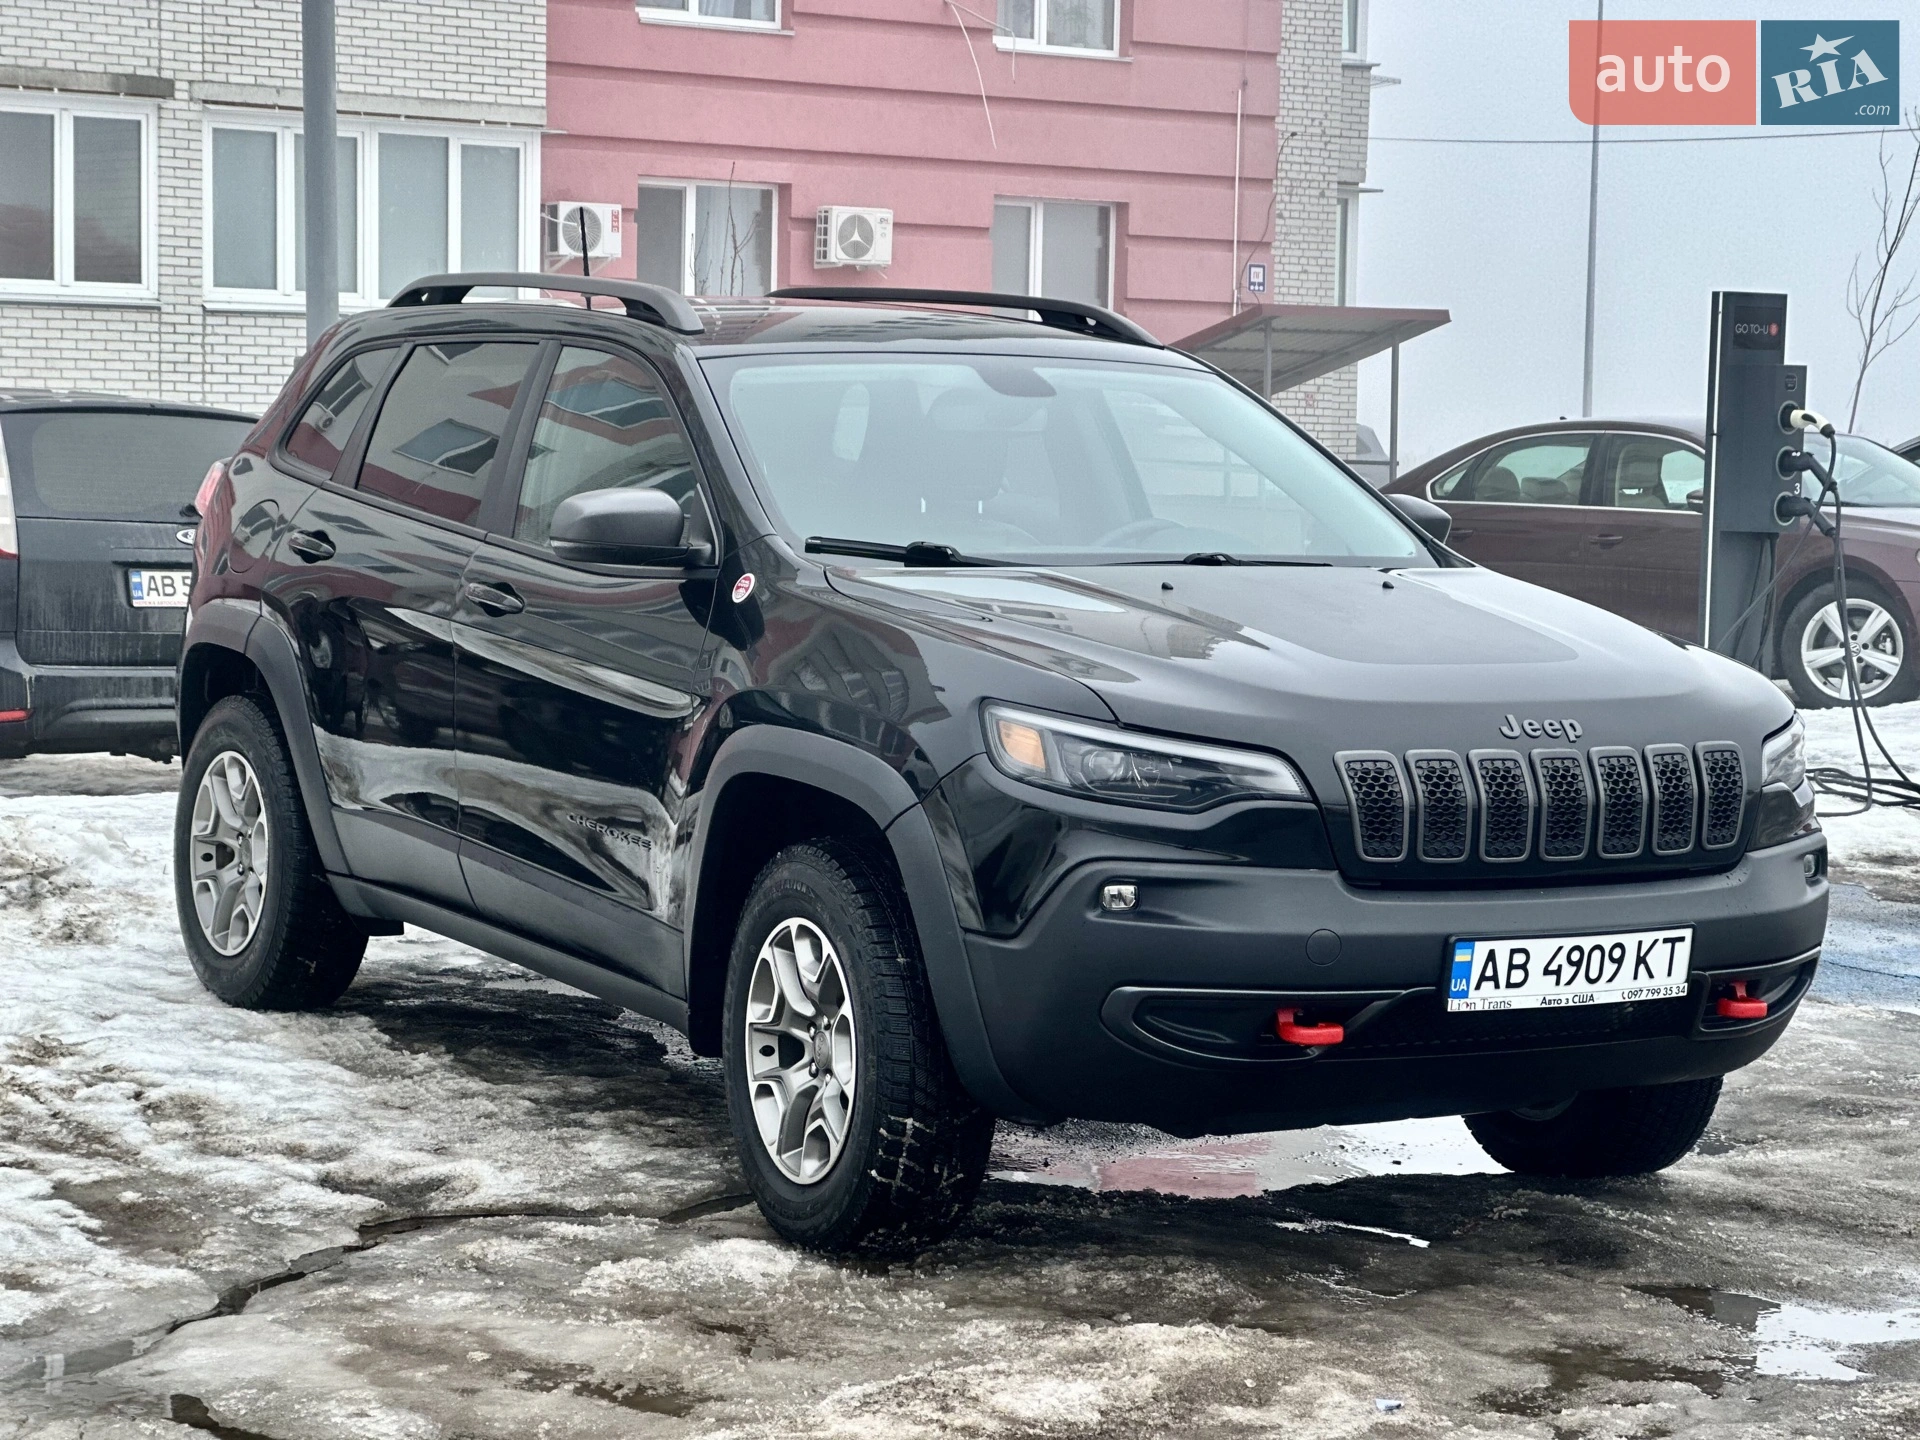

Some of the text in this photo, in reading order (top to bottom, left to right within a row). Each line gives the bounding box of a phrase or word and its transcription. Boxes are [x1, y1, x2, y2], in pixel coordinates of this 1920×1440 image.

[1735, 323, 1769, 335] GO TO-U
[1794, 482, 1801, 495] 3
[132, 589, 143, 597] UA
[146, 575, 177, 597] AB
[1499, 714, 1583, 743] Jeep
[566, 812, 652, 852] CHEROKEE
[1474, 936, 1686, 991] AB 4909 KT
[1451, 978, 1468, 992] UA
[1571, 993, 1595, 1004] США
[1627, 985, 1686, 1000] 097 799 35 34
[1480, 998, 1512, 1010] Trans
